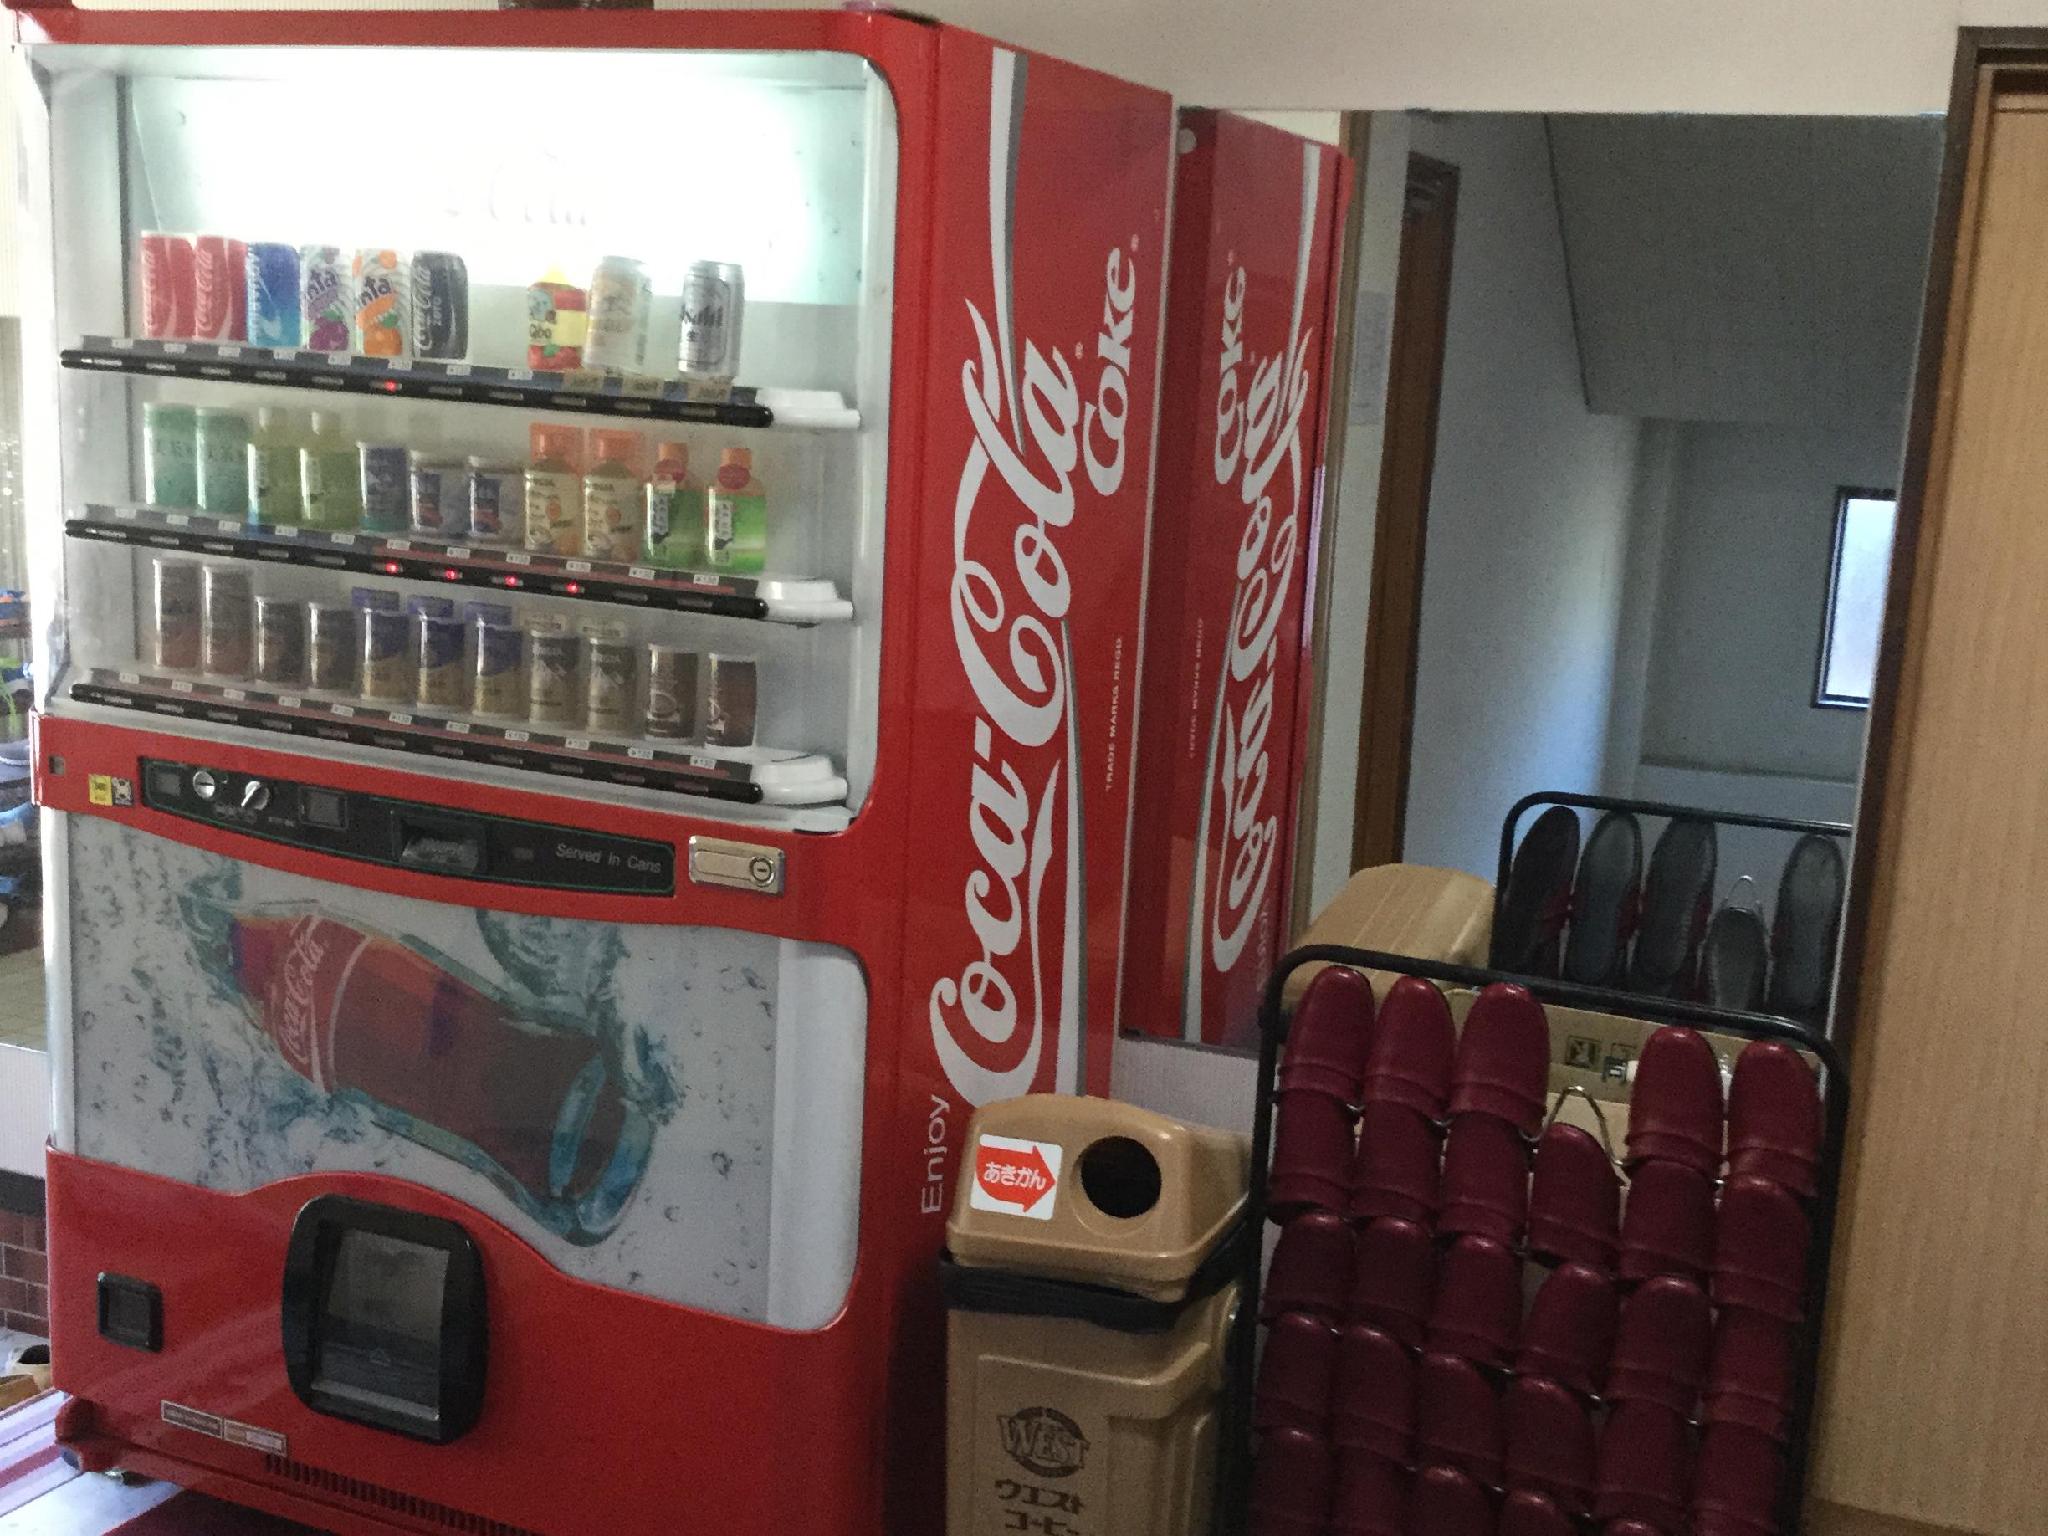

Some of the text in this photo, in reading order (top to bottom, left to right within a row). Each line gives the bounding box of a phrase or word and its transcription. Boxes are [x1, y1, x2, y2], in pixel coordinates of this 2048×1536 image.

[1083, 248, 1136, 495] Coke
[929, 298, 1079, 1109] Coca-Cola
[555, 842, 602, 864] Served
[627, 855, 661, 873] Cans
[921, 1095, 951, 1215] Enjoy
[984, 1161, 1047, 1190] あきかん
